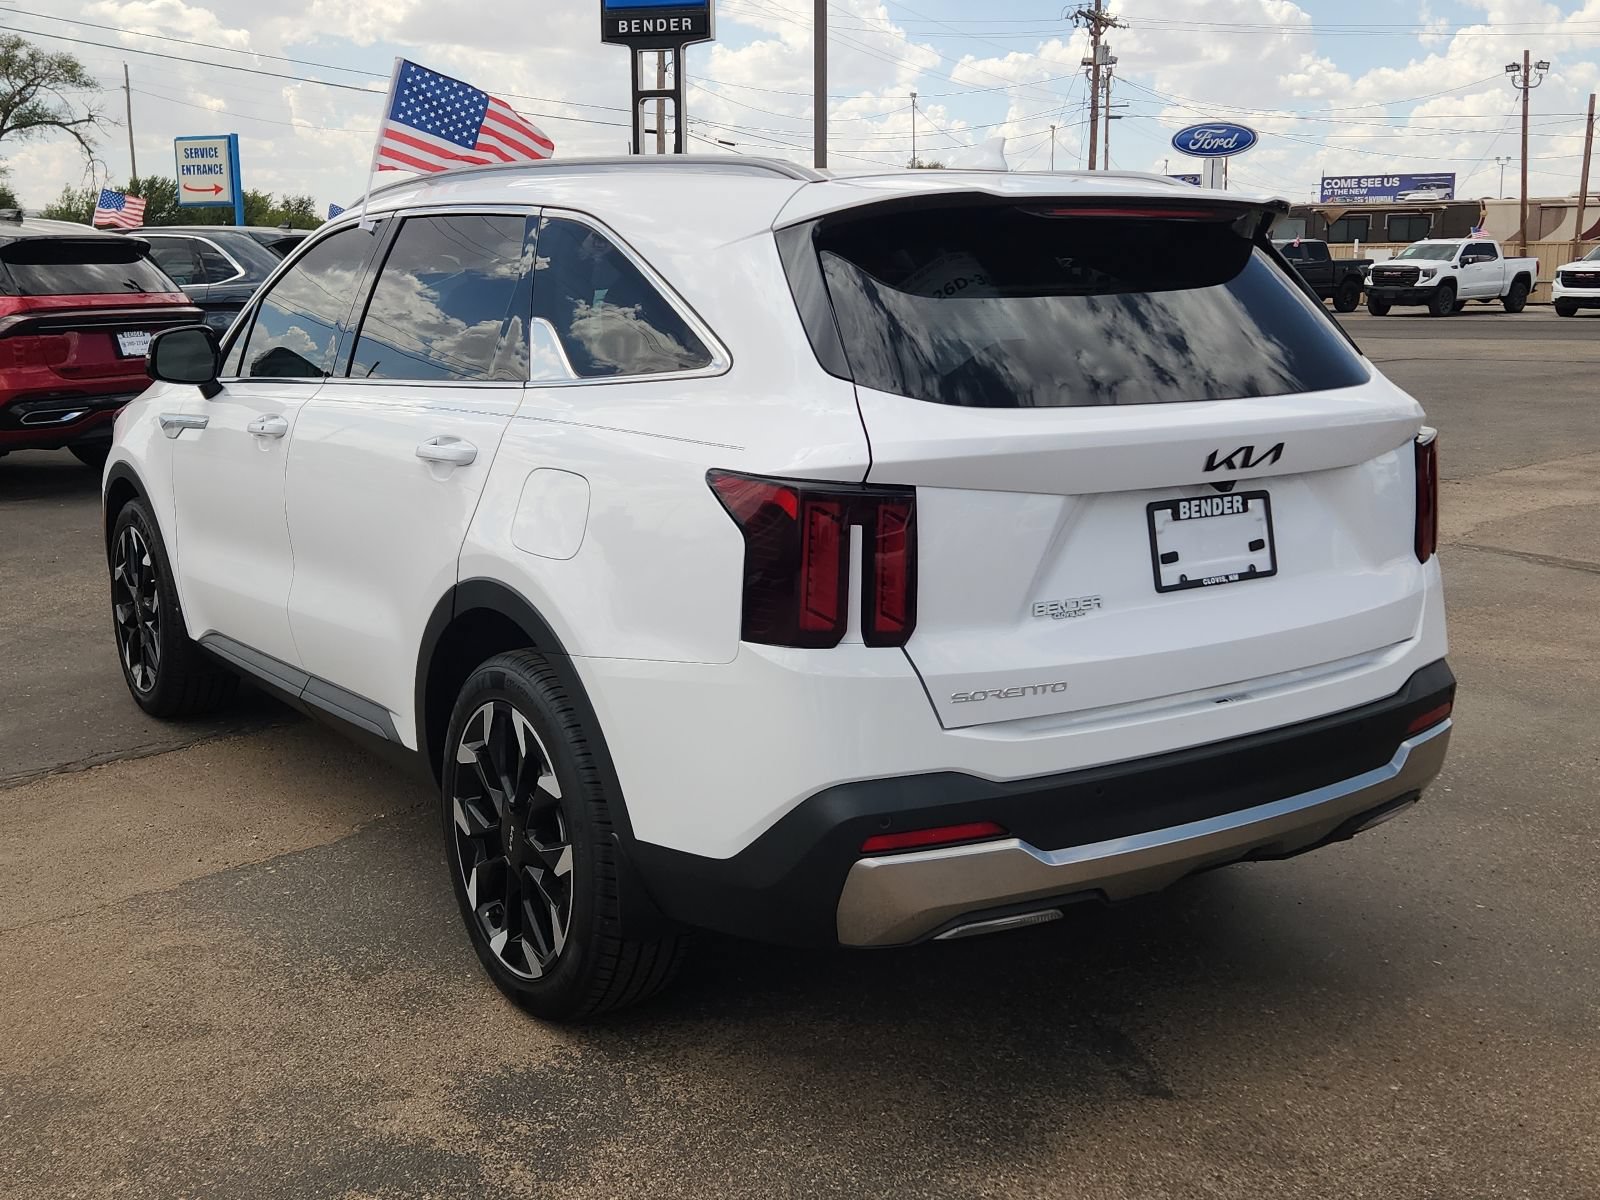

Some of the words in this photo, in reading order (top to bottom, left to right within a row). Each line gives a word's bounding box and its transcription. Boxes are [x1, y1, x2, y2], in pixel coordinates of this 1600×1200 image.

[618, 17, 692, 33] BENDER
[1188, 128, 1239, 150] Ford
[183, 146, 219, 159] SERVICE
[181, 163, 224, 176] ENTRANCE
[1323, 179, 1358, 189] COME
[1360, 178, 1382, 187] SEE
[1383, 177, 1400, 187] US
[1202, 442, 1285, 472] KIA
[1179, 495, 1244, 520] BENDER
[1032, 595, 1102, 617] BENDER
[950, 681, 1067, 704] SORENTO
